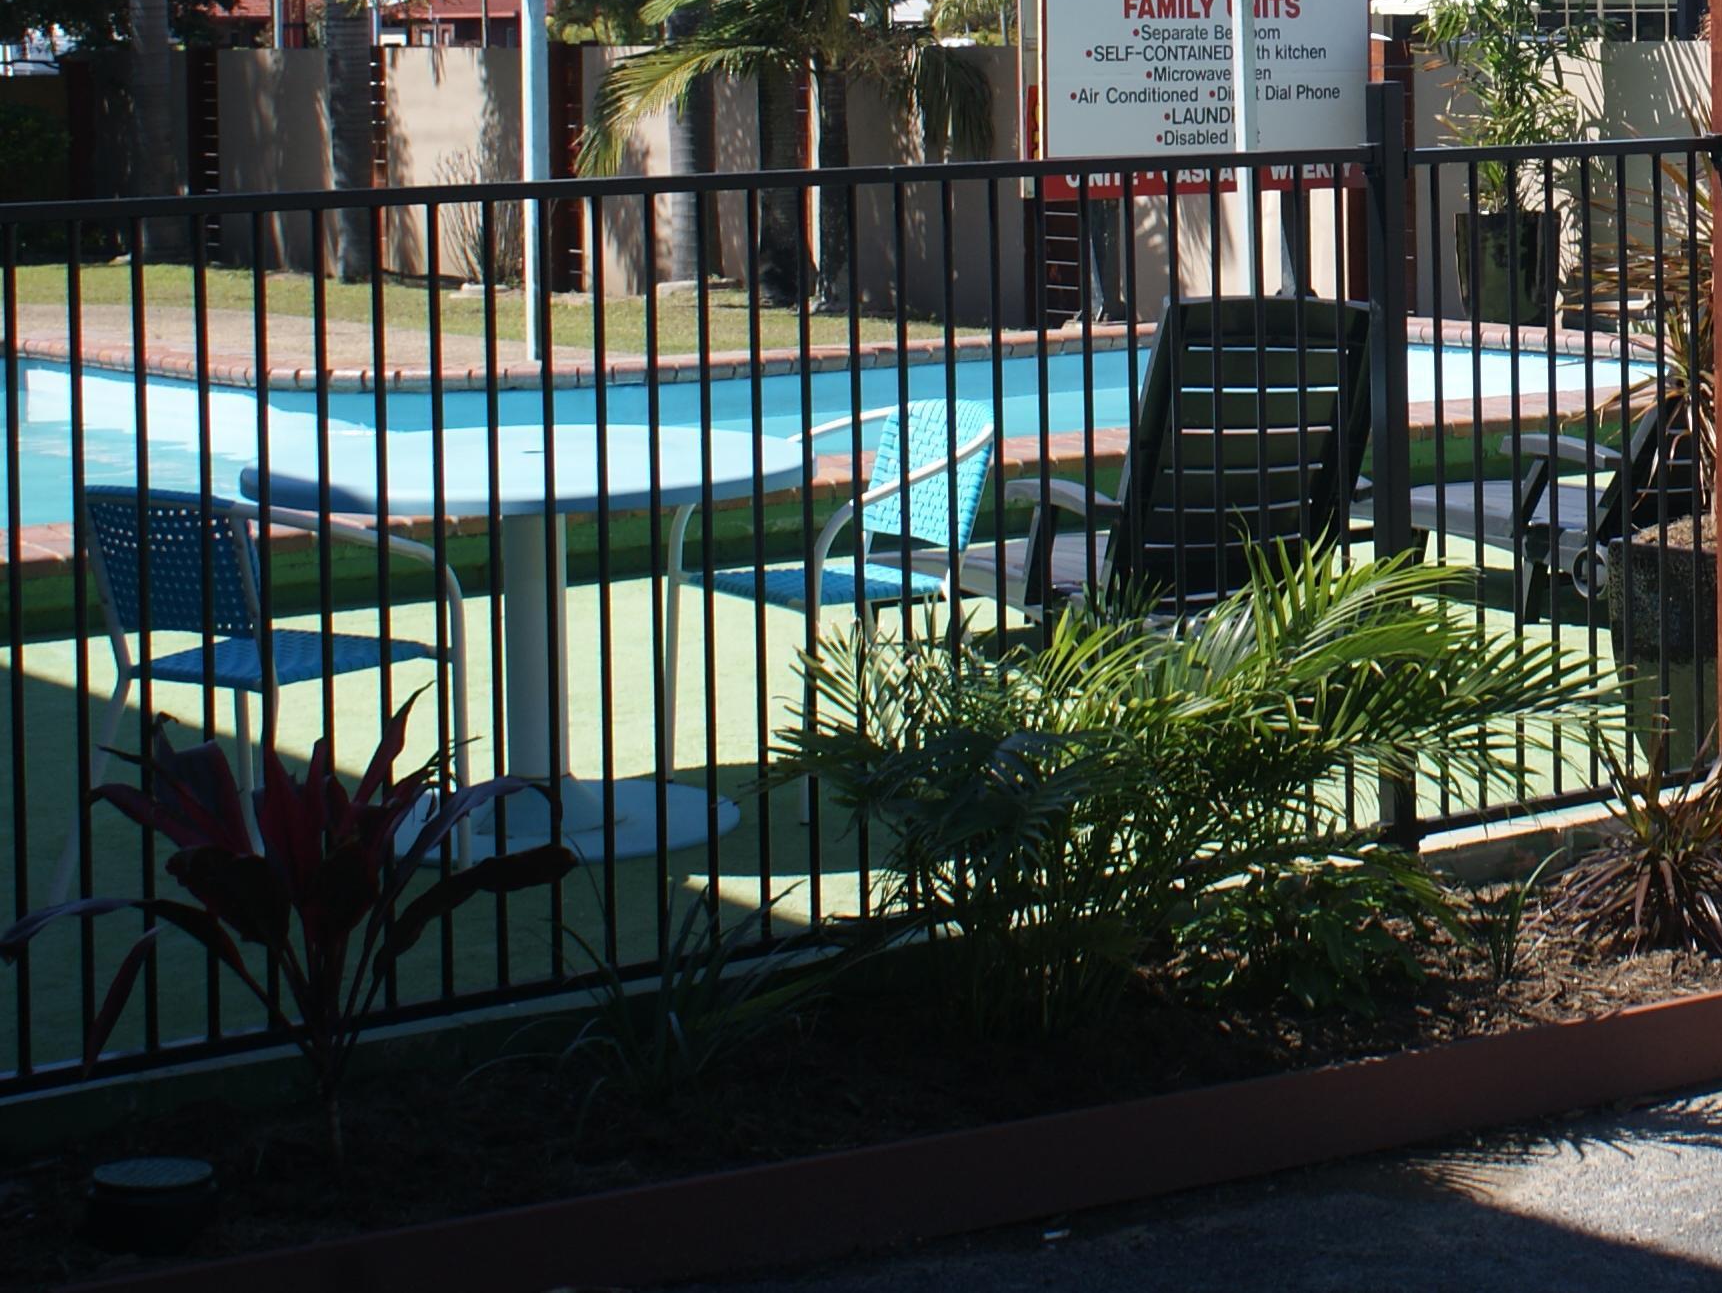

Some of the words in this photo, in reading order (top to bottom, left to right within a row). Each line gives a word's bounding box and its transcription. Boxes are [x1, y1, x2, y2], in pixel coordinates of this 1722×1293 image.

[1141, 23, 1209, 44] Separate
[1214, 24, 1281, 41] Beom
[1093, 44, 1234, 62] SELF-CONTAINED
[1275, 44, 1327, 60] kitchen
[1153, 65, 1232, 83] Microwave
[1078, 87, 1100, 104] Air
[1106, 86, 1199, 104] Conditioned
[1265, 85, 1292, 101] Dial
[1296, 84, 1341, 100] Phone
[1171, 106, 1236, 125] LAUND
[1164, 129, 1229, 146] Disabled
